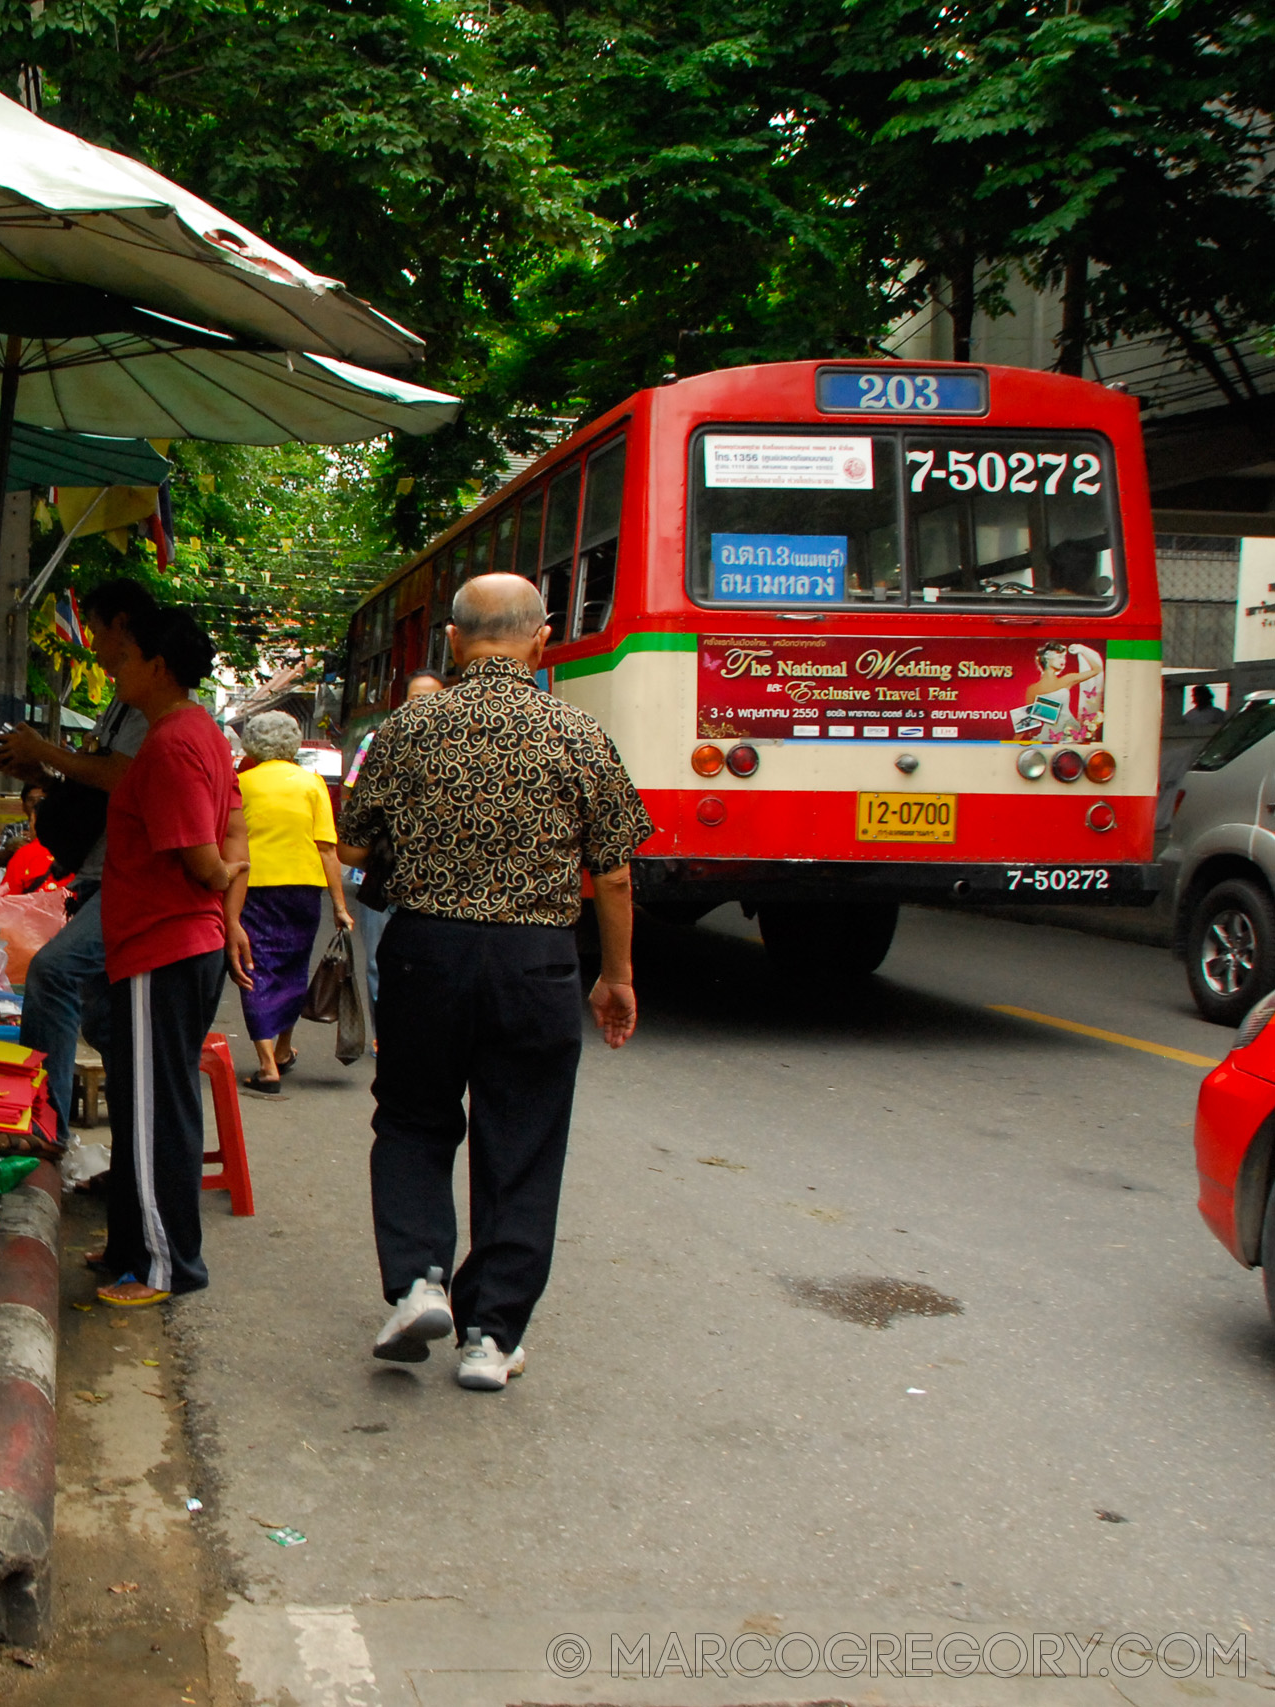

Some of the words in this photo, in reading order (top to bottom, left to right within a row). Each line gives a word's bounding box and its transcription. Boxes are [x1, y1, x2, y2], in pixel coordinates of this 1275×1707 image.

[858, 375, 940, 410] 203
[906, 450, 1102, 495] 7-50272
[720, 574, 836, 596] สนามหลวง
[720, 648, 773, 679] The
[777, 661, 847, 677] National
[855, 646, 952, 681] Wedding
[957, 661, 1013, 678] Shows
[766, 684, 783, 693] และ
[785, 681, 871, 704] Exclusive
[875, 687, 921, 701] Travel
[928, 687, 959, 701] Fair
[737, 708, 790, 720] พฤษภาคม
[792, 708, 819, 718] 2550
[931, 710, 1008, 720] สยามพารากอน
[867, 801, 950, 825] 12-0700
[1006, 869, 1109, 891] 7-50272
